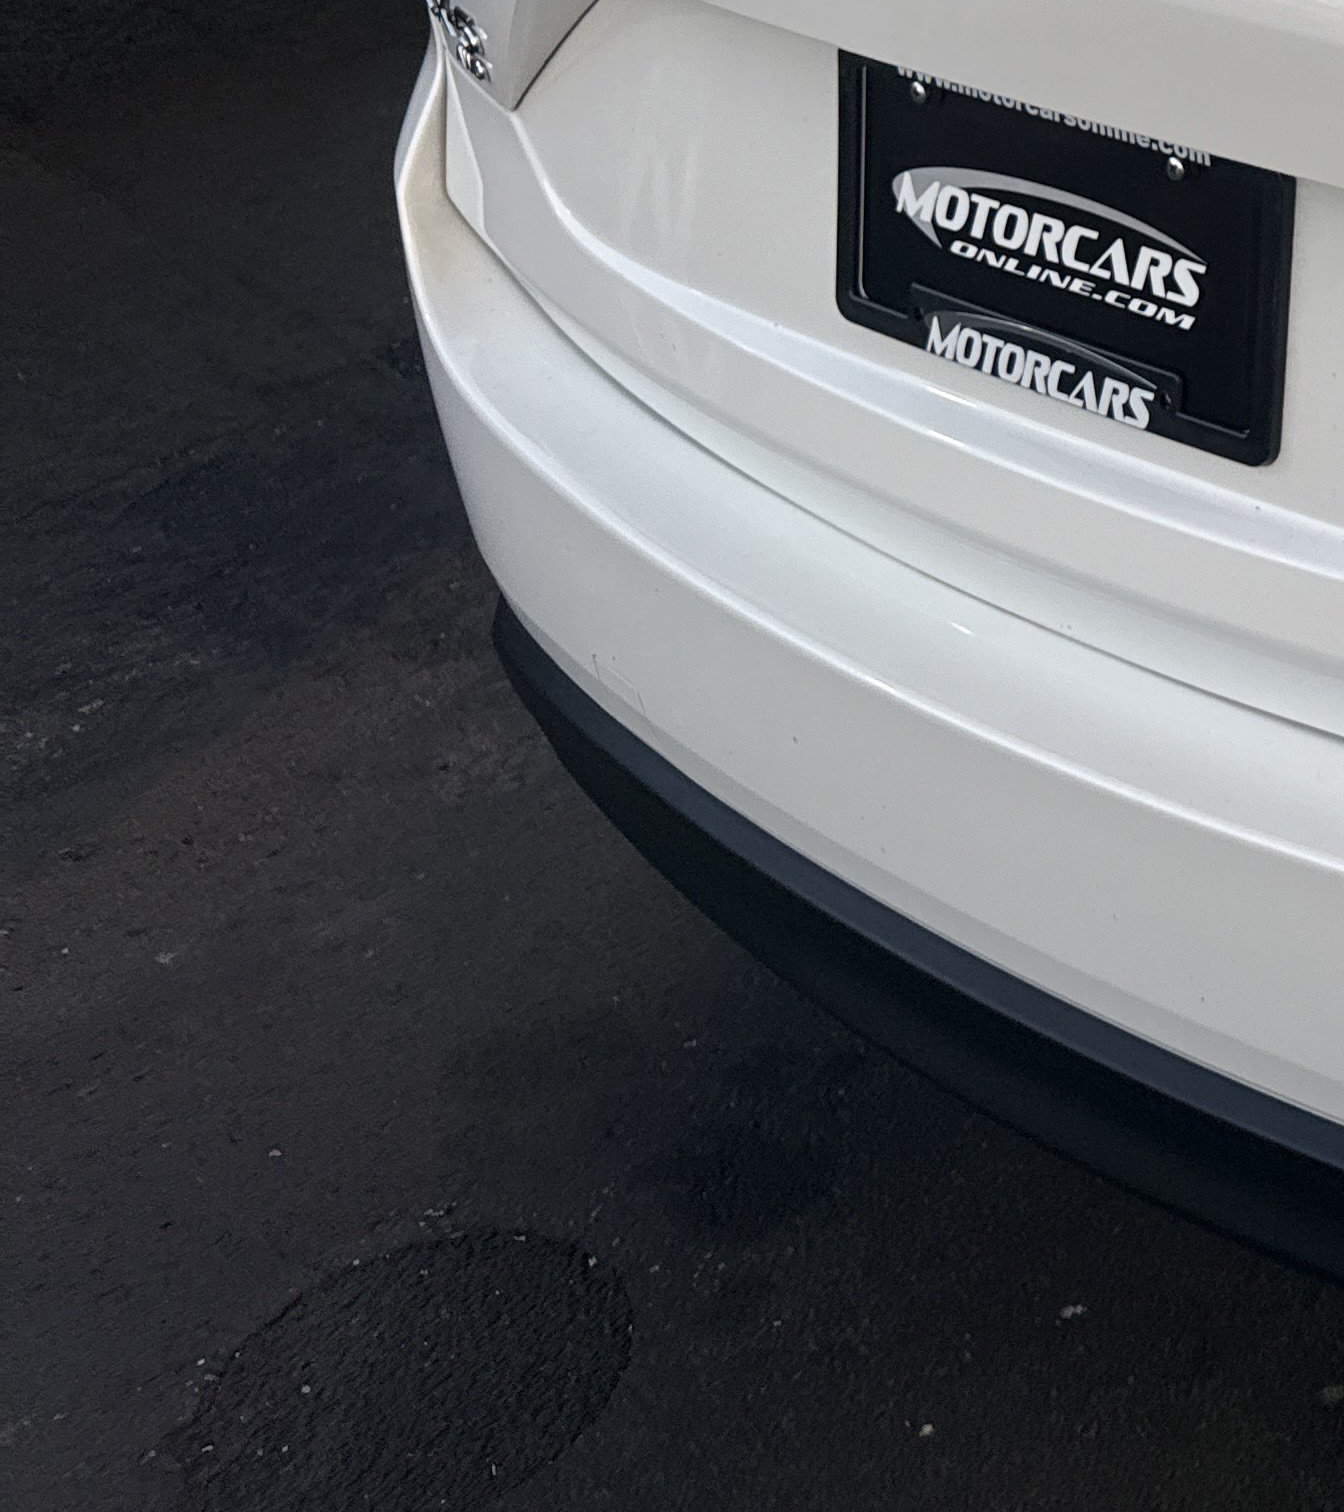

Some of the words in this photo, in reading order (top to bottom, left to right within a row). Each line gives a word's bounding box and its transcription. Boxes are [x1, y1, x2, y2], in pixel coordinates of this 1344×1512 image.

[896, 172, 1206, 306] MOTORCARS
[950, 240, 1196, 330] ONLINE.COM
[927, 315, 1155, 429] MOTORCARS
